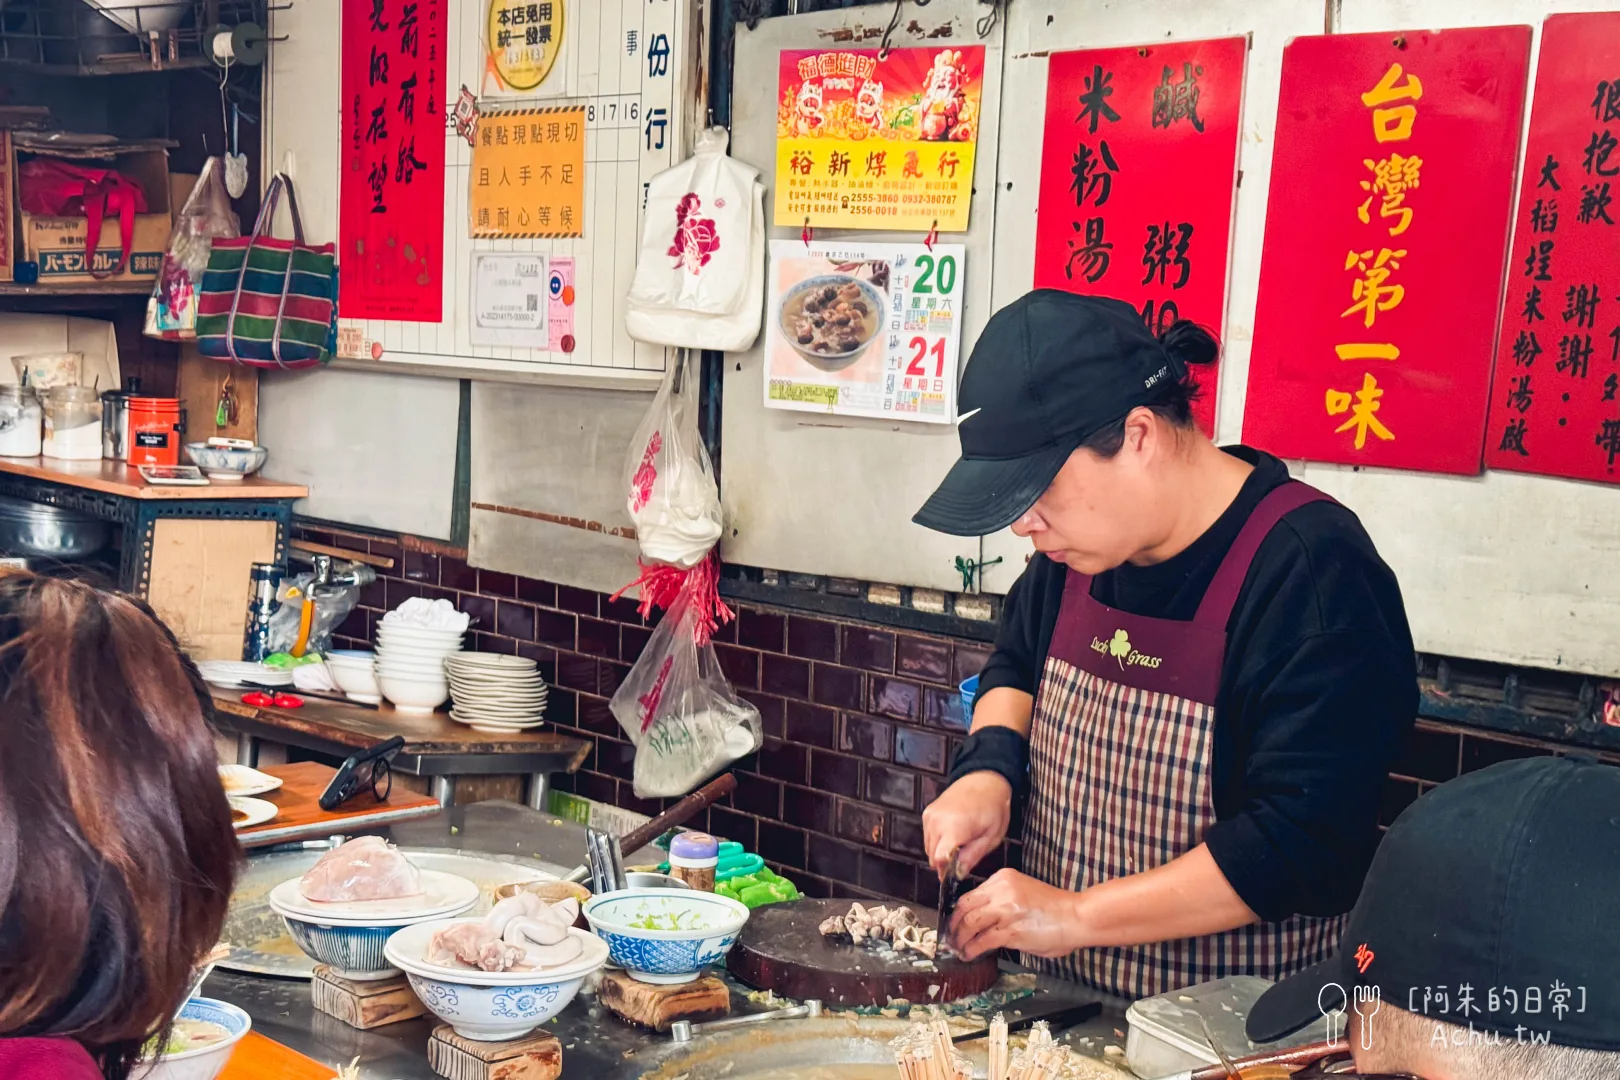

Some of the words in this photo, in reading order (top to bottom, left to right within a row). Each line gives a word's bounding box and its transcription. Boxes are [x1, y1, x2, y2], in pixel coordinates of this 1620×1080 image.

[497, 3, 552, 26] 本店免用
[498, 24, 551, 48] 統一發票
[626, 30, 638, 56] 事
[603, 104, 617, 121] 17
[625, 103, 638, 120] 16
[481, 122, 578, 146] 餐點現點現切
[478, 164, 573, 187] 且人手不足
[789, 150, 960, 179] 裕新煤氣行
[1064, 64, 1121, 284] 米粉湯
[477, 206, 573, 228] 請耐心等候
[1324, 62, 1424, 450] 台灣第一味
[912, 254, 956, 295] 20
[911, 297, 953, 310] 星期六
[905, 335, 946, 378] 21
[903, 377, 943, 392] 星期日
[1144, 365, 1168, 389] DRI-FIT
[1126, 649, 1163, 669] Grass
